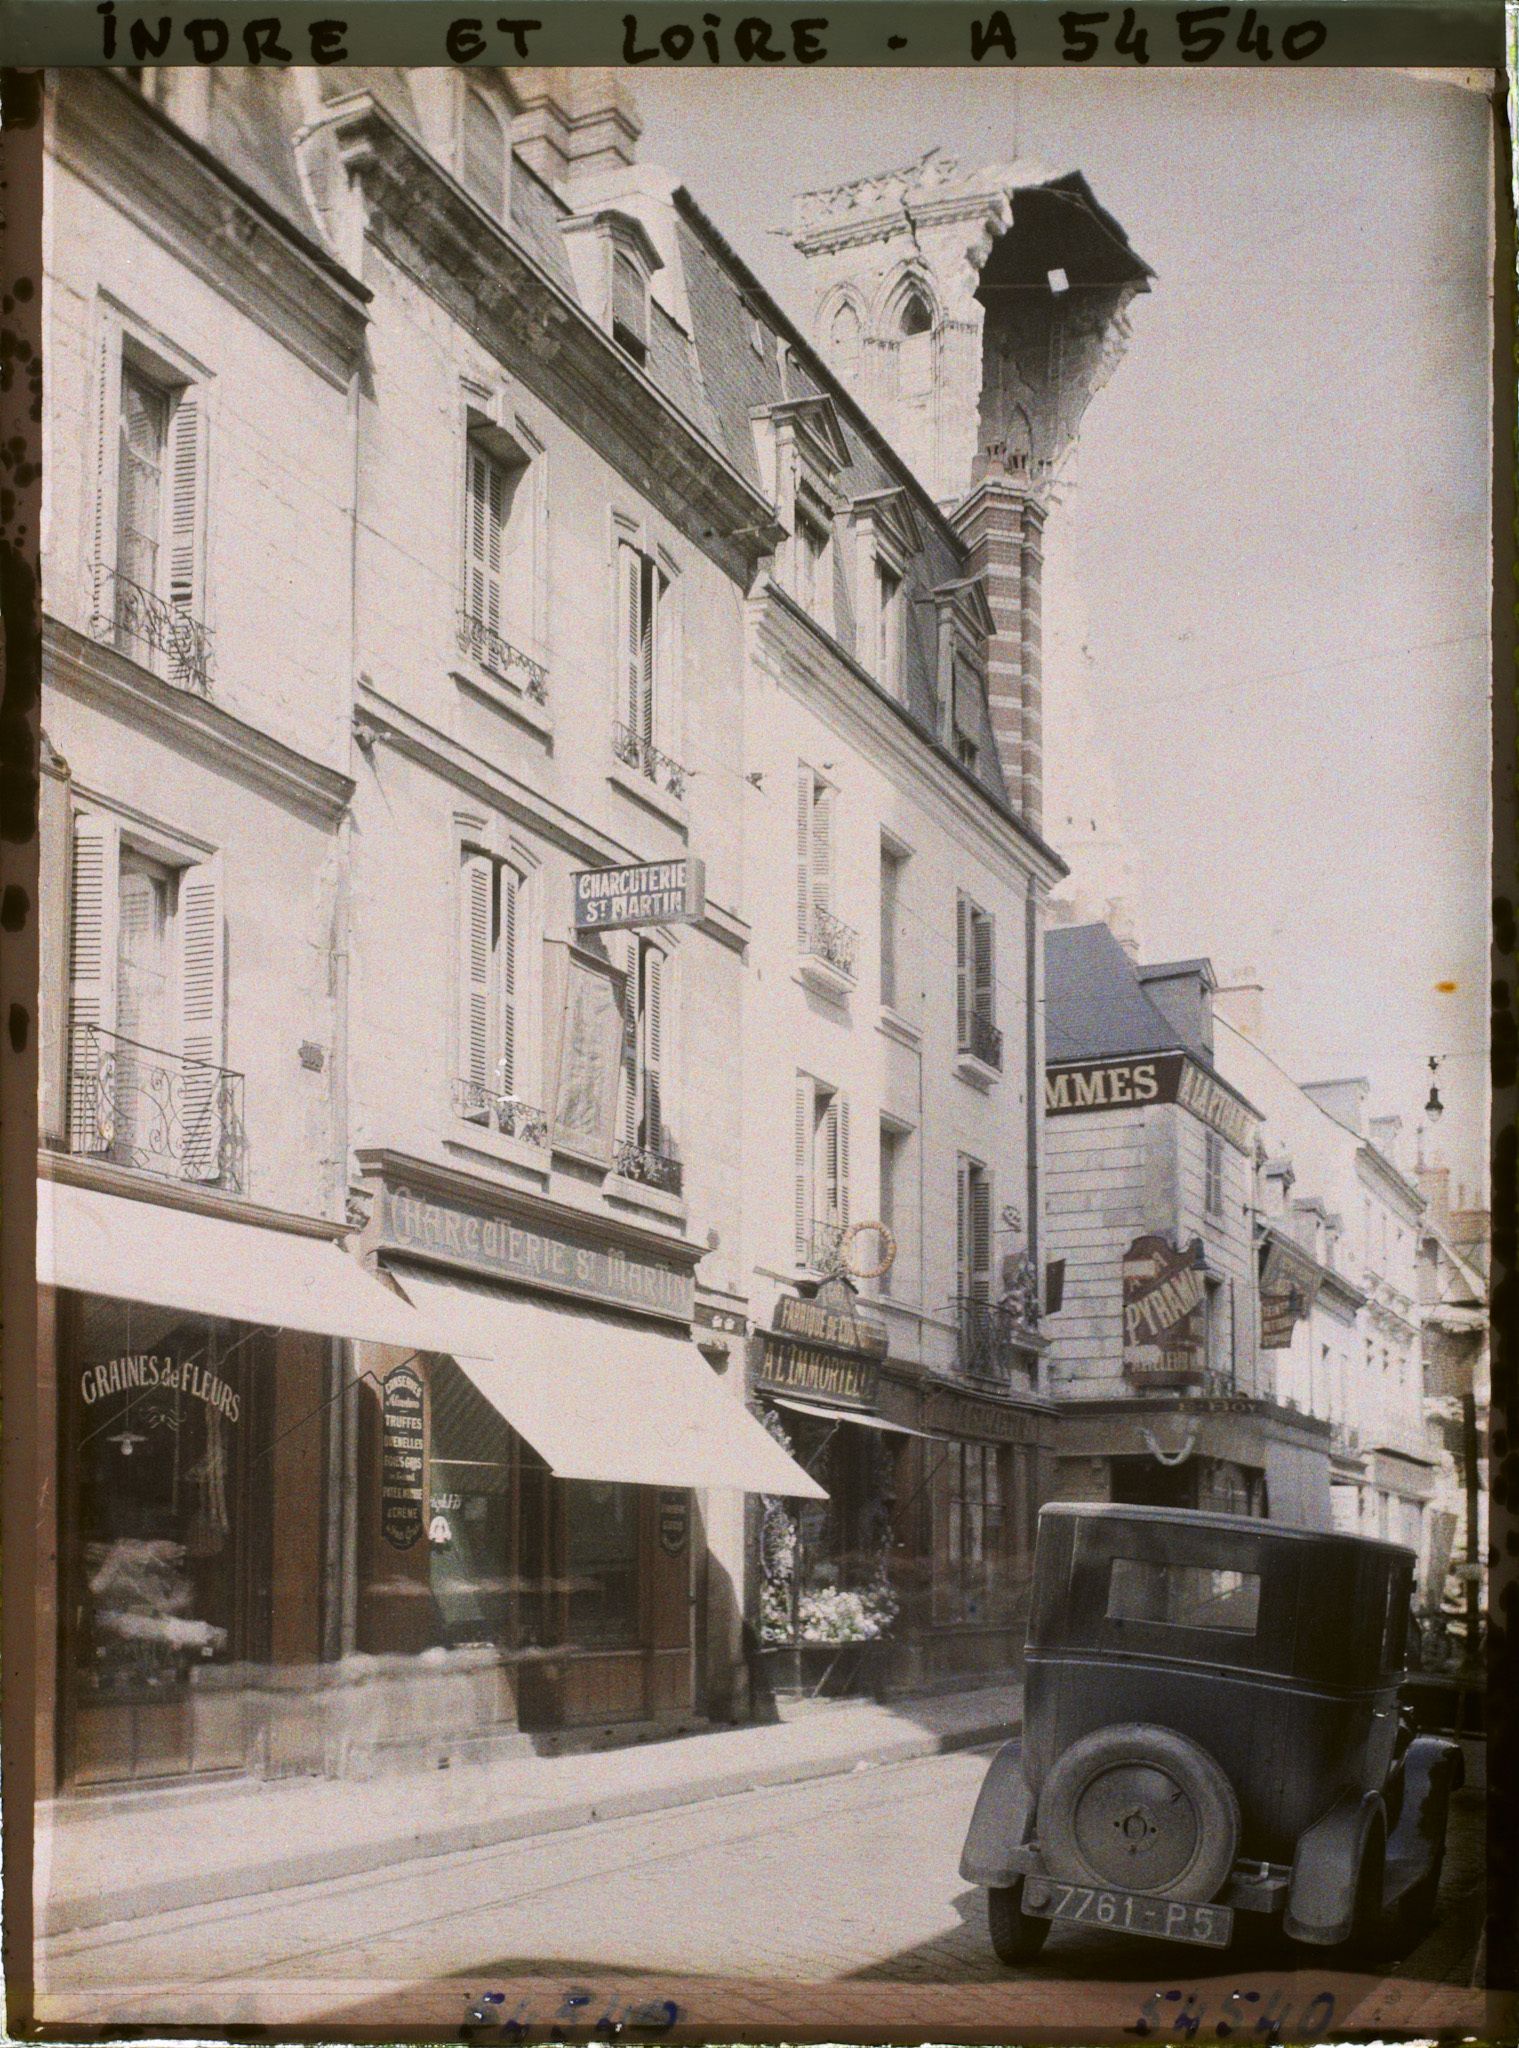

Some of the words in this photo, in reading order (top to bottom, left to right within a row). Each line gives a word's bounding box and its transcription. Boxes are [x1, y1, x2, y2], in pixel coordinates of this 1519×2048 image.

[579, 863, 687, 899] CHARCUTERIE
[611, 892, 682, 920] MARTIN
[81, 1355, 160, 1405] GRAINES
[160, 1357, 180, 1389] de
[180, 1362, 241, 1423] FLEURS
[385, 1414, 422, 1430] TRUFFES
